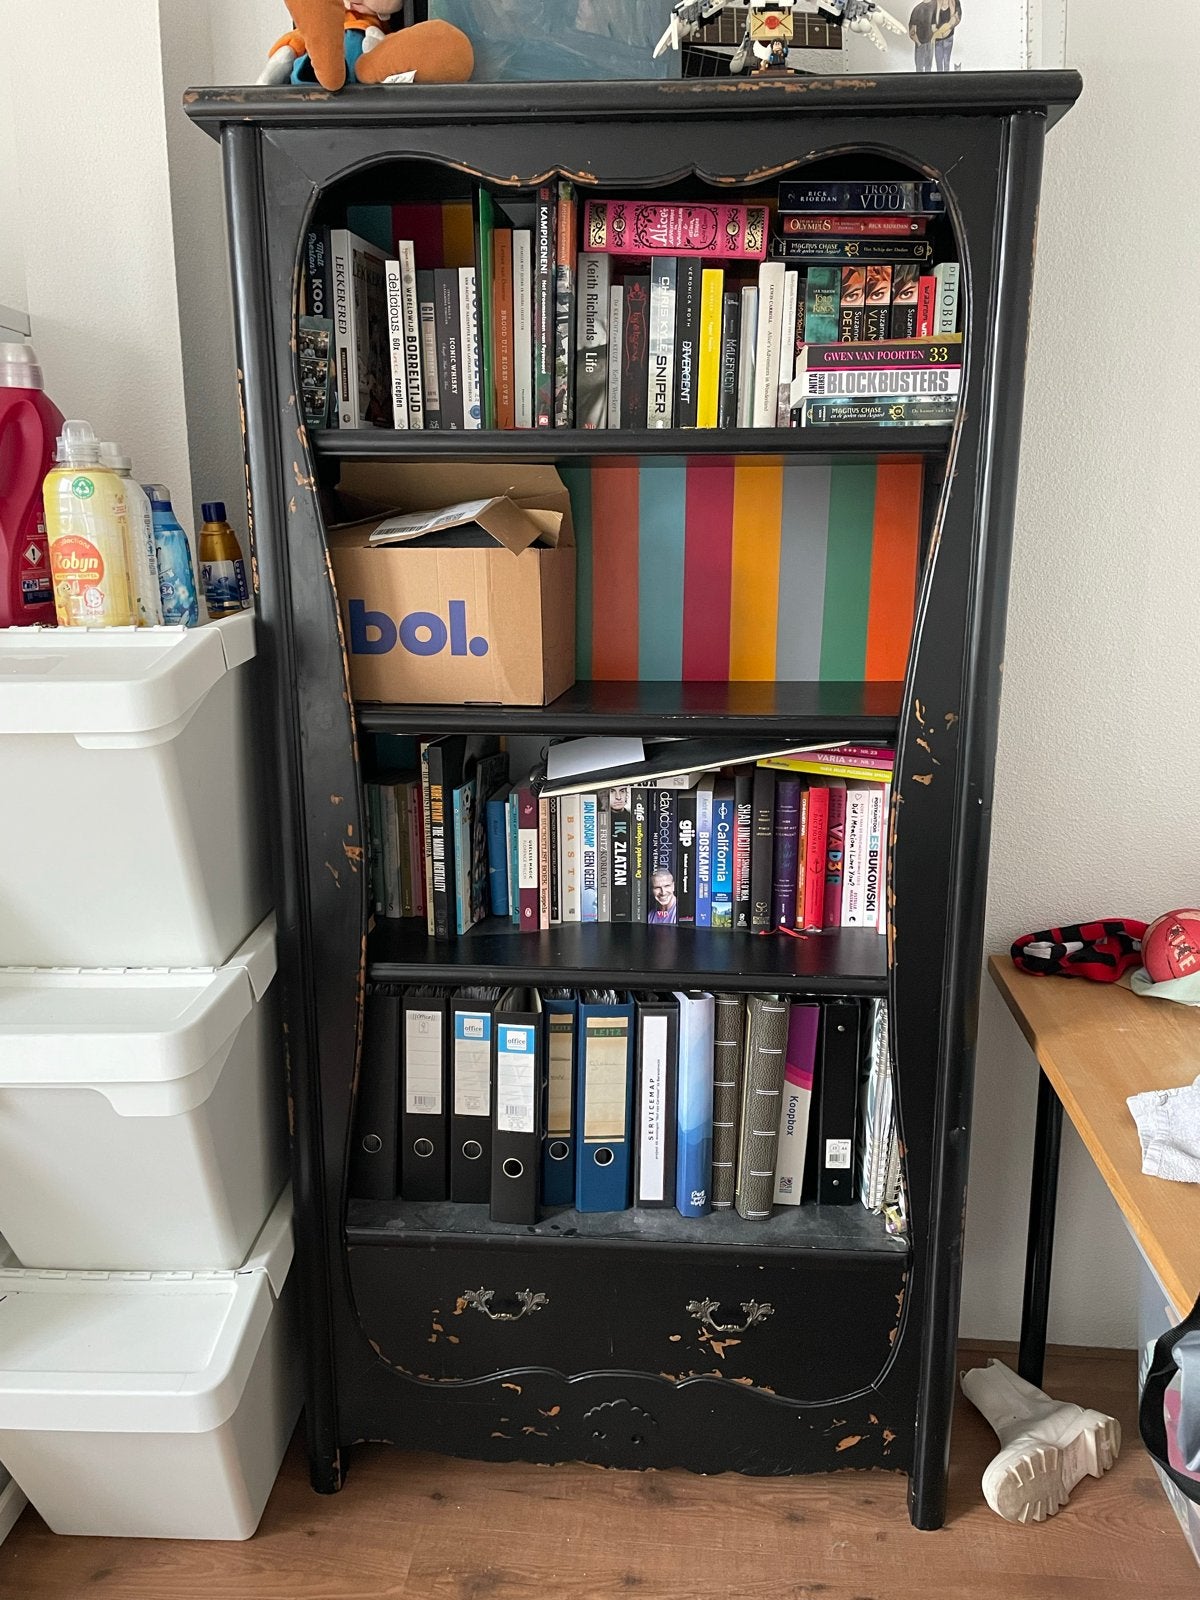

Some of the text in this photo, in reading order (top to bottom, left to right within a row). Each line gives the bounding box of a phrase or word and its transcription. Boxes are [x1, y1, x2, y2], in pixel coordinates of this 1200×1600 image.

[540, 206, 548, 274] KAMPIOENEN!
[648, 208, 668, 247] Alice's
[790, 218, 831, 231] OLYMPUS
[308, 232, 318, 276] Preston's
[316, 242, 324, 268] Matt
[948, 266, 956, 278] DE
[388, 272, 401, 334] delicious.
[406, 286, 415, 332] WERELDWIJD
[422, 306, 434, 322] GIN
[585, 260, 598, 372] Keith Richards Life
[448, 337, 458, 394] ICONIC WHISKY
[655, 276, 670, 414] CHRIS KYLE SNIPER
[725, 338, 736, 394] MALEFICENT
[824, 347, 948, 362] GWEN VAN POORTEN 33
[406, 335, 422, 412] BORRELTIJD
[680, 340, 692, 404] DIVERGENT
[808, 373, 818, 394] ANITA
[826, 371, 949, 394] BLOCKBUSTERS
[162, 586, 173, 595] 34
[348, 600, 488, 656] bol.
[816, 754, 846, 764] VARIA
[634, 803, 645, 821] gijp
[678, 820, 695, 846] gijp
[737, 804, 751, 851] SHAQ UNCUT
[431, 785, 446, 892] KOBE BRYANT THE MAMBA MENTALITY
[584, 802, 595, 891] JAN BOSKAMP GEEN GEZEIK
[612, 821, 627, 886] IK, ZLATAN
[634, 822, 642, 846] volgens
[716, 822, 730, 882] California
[827, 823, 843, 886] VAD3R
[850, 819, 858, 849] Mention
[635, 870, 642, 878] De
[699, 832, 709, 882] BOSKAMP
[741, 885, 749, 902] O'NEAL
[848, 871, 856, 886] You?
[540, 888, 548, 914] koppels
[1169, 924, 1196, 972] NIKE
[786, 1095, 799, 1136] Koopbox
